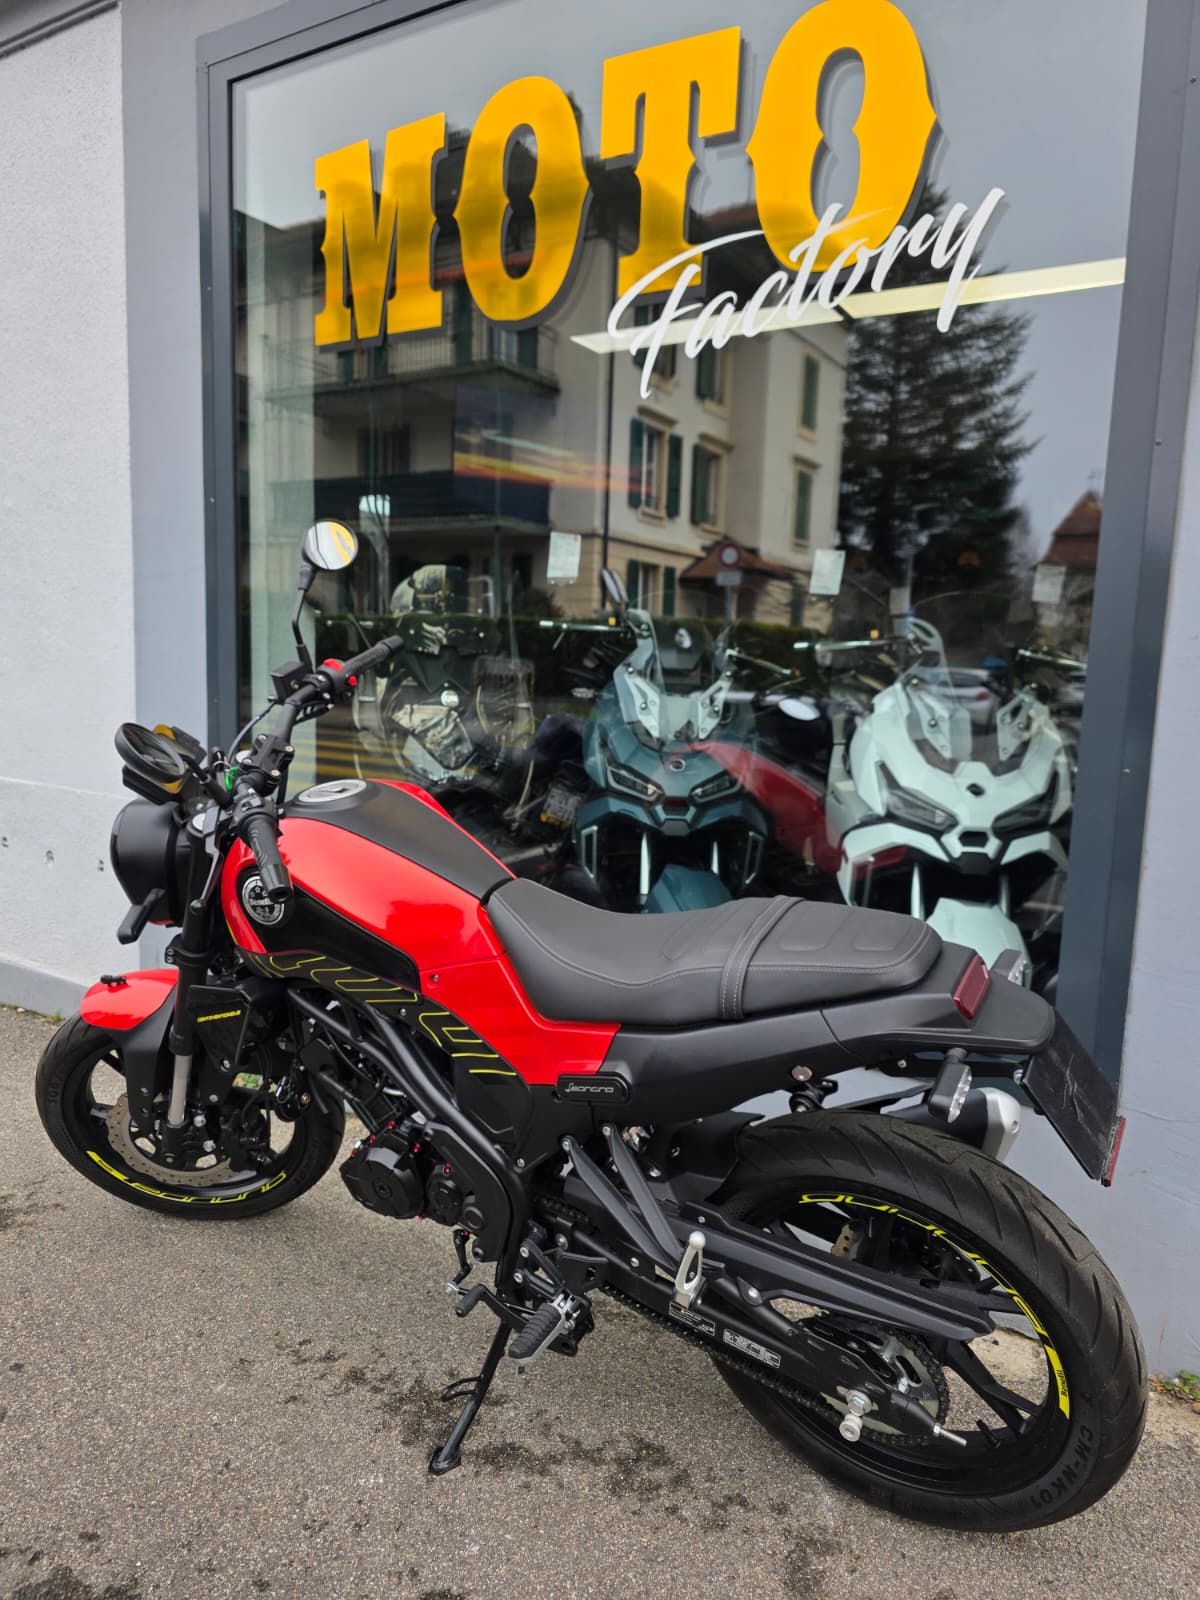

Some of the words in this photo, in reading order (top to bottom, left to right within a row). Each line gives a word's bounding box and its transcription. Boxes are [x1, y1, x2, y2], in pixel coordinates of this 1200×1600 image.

[315, 0, 936, 345] MOTO
[608, 188, 1005, 398] Factory
[1029, 1424, 1094, 1508] CM-NK01
